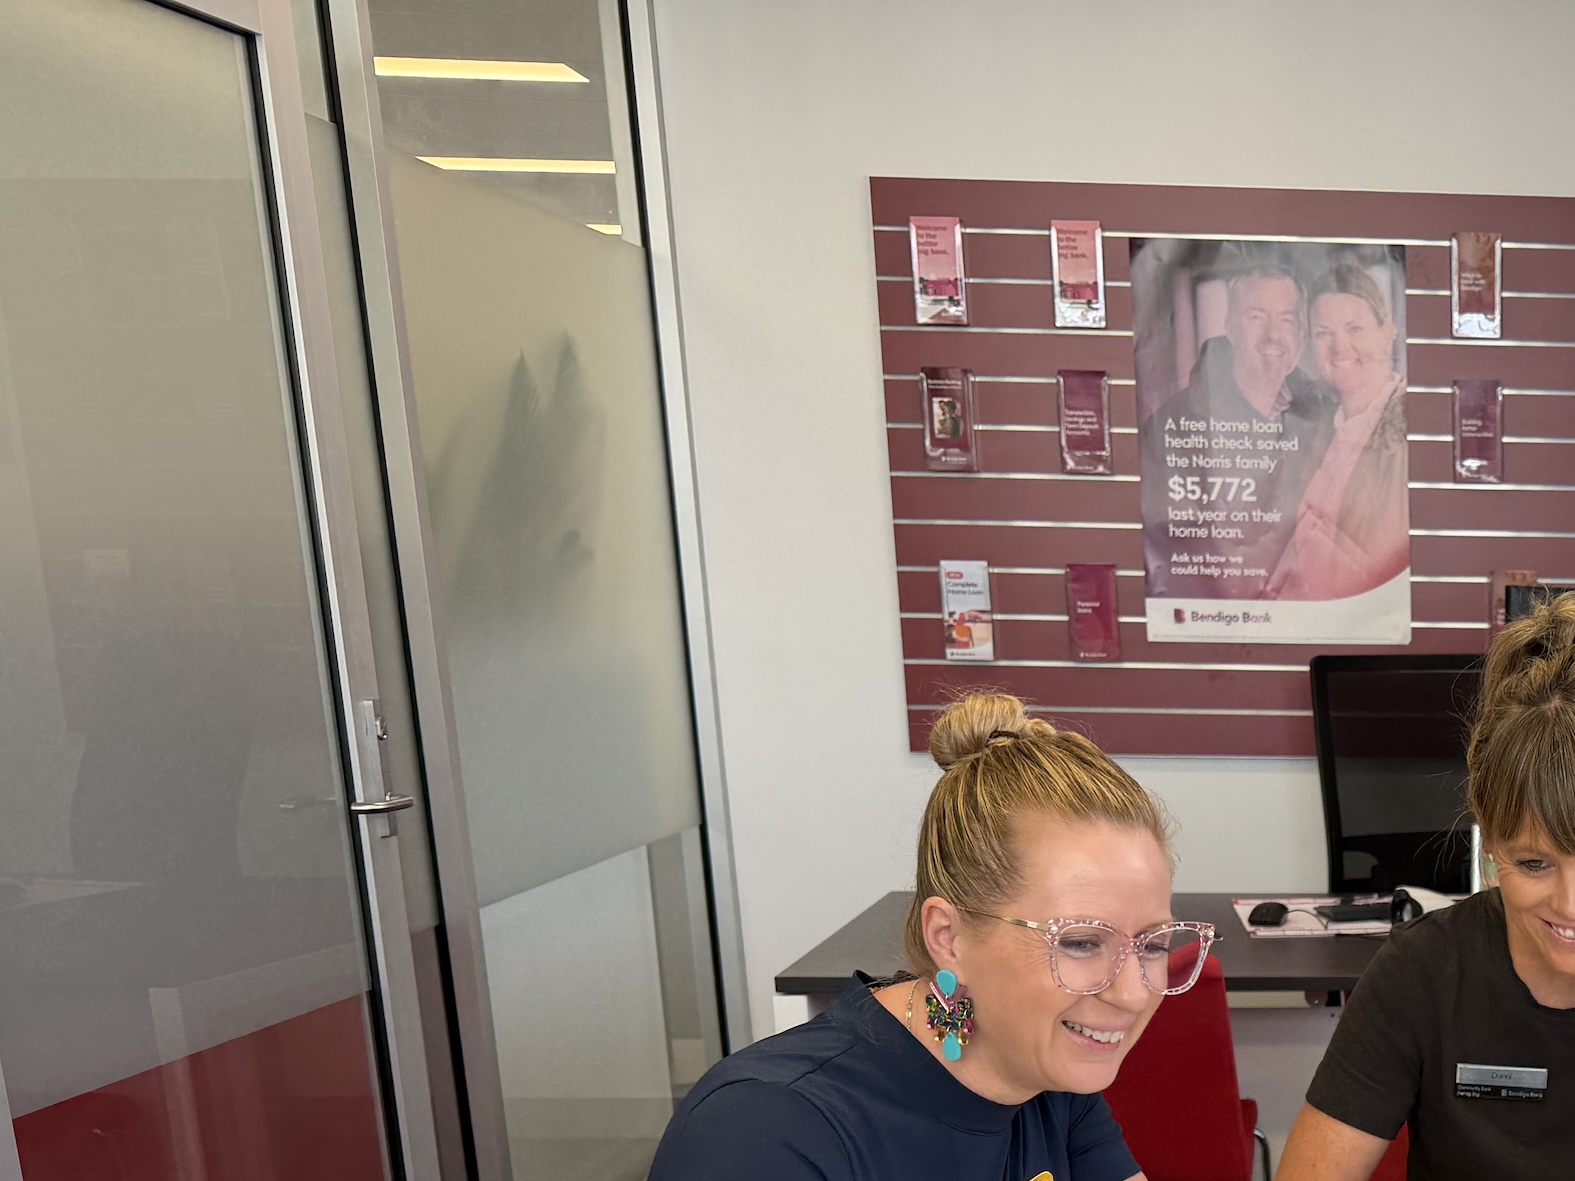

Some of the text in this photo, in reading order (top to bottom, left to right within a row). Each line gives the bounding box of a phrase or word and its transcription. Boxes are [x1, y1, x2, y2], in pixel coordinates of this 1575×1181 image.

[1165, 417, 1283, 434] A free home loan
[1165, 434, 1299, 451] health check saved
[1166, 454, 1278, 474] the Norris family
[1168, 475, 1257, 504] $5,772
[1168, 507, 1282, 525] last year on their
[1168, 524, 1245, 539] home loan.
[1171, 553, 1244, 565] Ask us how we
[1171, 566, 1269, 578] could help you save.
[1191, 610, 1272, 626] Bendigo Bank
